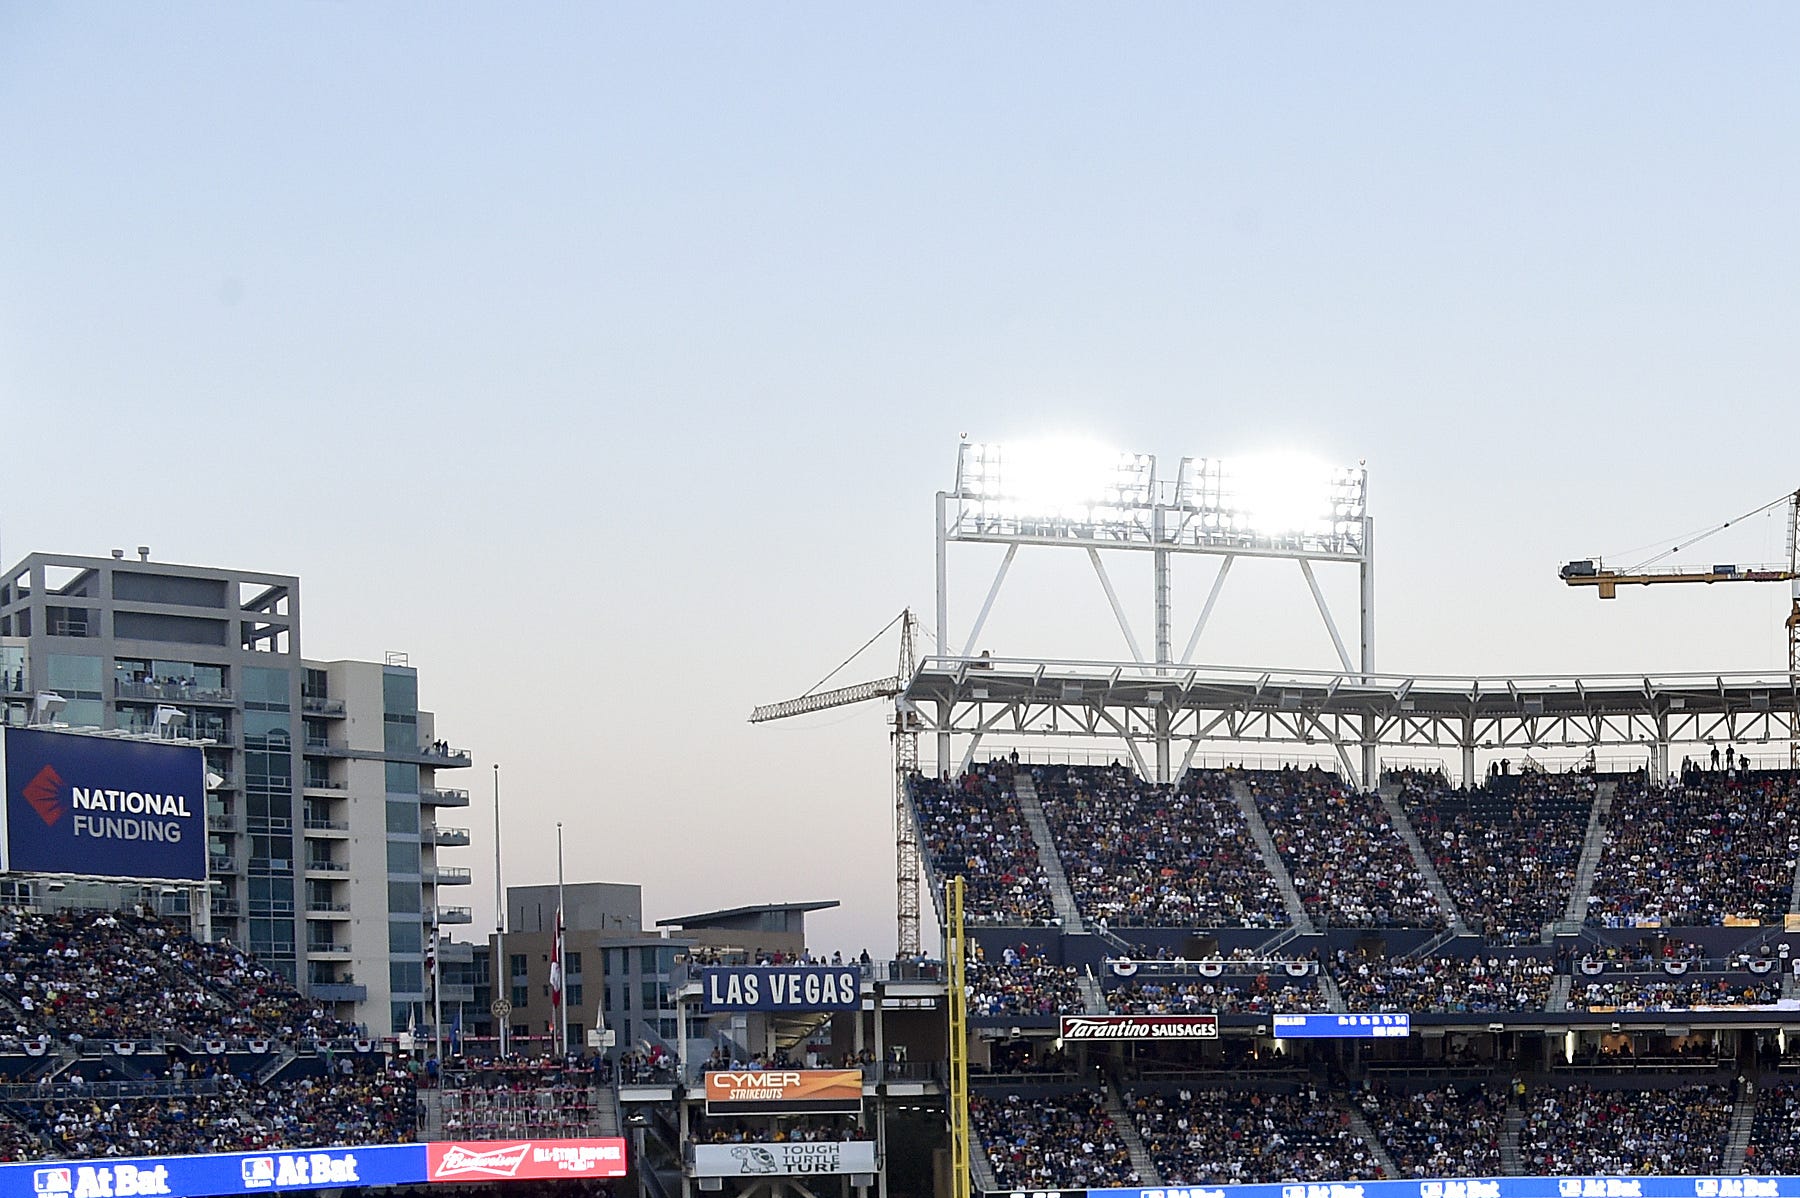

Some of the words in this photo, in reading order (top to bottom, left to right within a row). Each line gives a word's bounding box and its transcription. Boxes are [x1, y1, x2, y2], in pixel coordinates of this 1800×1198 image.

[73, 787, 191, 817] NATIONAL
[74, 815, 181, 843] FUNDING
[711, 974, 759, 1004] LAS
[769, 973, 854, 1004] VEGAS
[1064, 1019, 1149, 1038] Tarantino
[1152, 1023, 1216, 1037] SAUSAGES
[714, 1072, 800, 1088] CYMER
[729, 1088, 783, 1099] STRIKEOUTS
[783, 1145, 840, 1154] TOUGH
[443, 1151, 521, 1169] Budweiser
[783, 1155, 840, 1164] TURTLE
[783, 1164, 840, 1172] TURF
[276, 1155, 310, 1185] At
[310, 1153, 360, 1184] Bat
[75, 1166, 113, 1198] At
[115, 1164, 171, 1197] Bat
